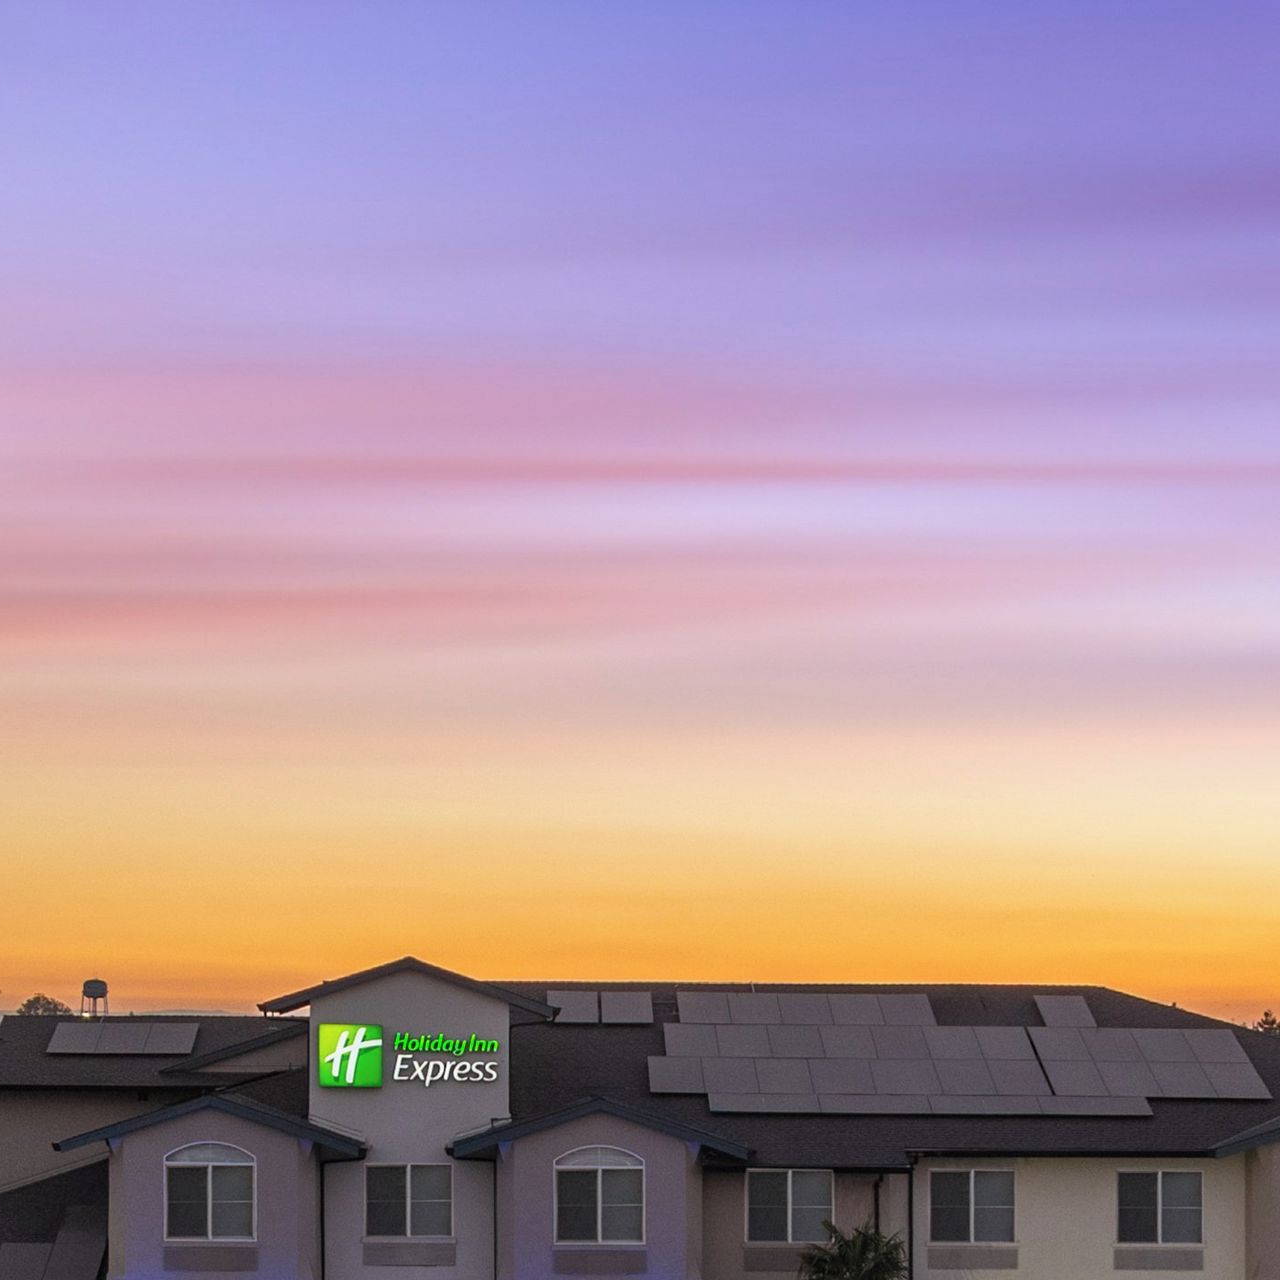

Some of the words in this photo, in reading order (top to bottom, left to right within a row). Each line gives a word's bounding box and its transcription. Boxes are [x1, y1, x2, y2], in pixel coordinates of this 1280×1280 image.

[393, 1032, 467, 1057] Holiday
[469, 1032, 500, 1053] Inn
[393, 1054, 499, 1087] Express
